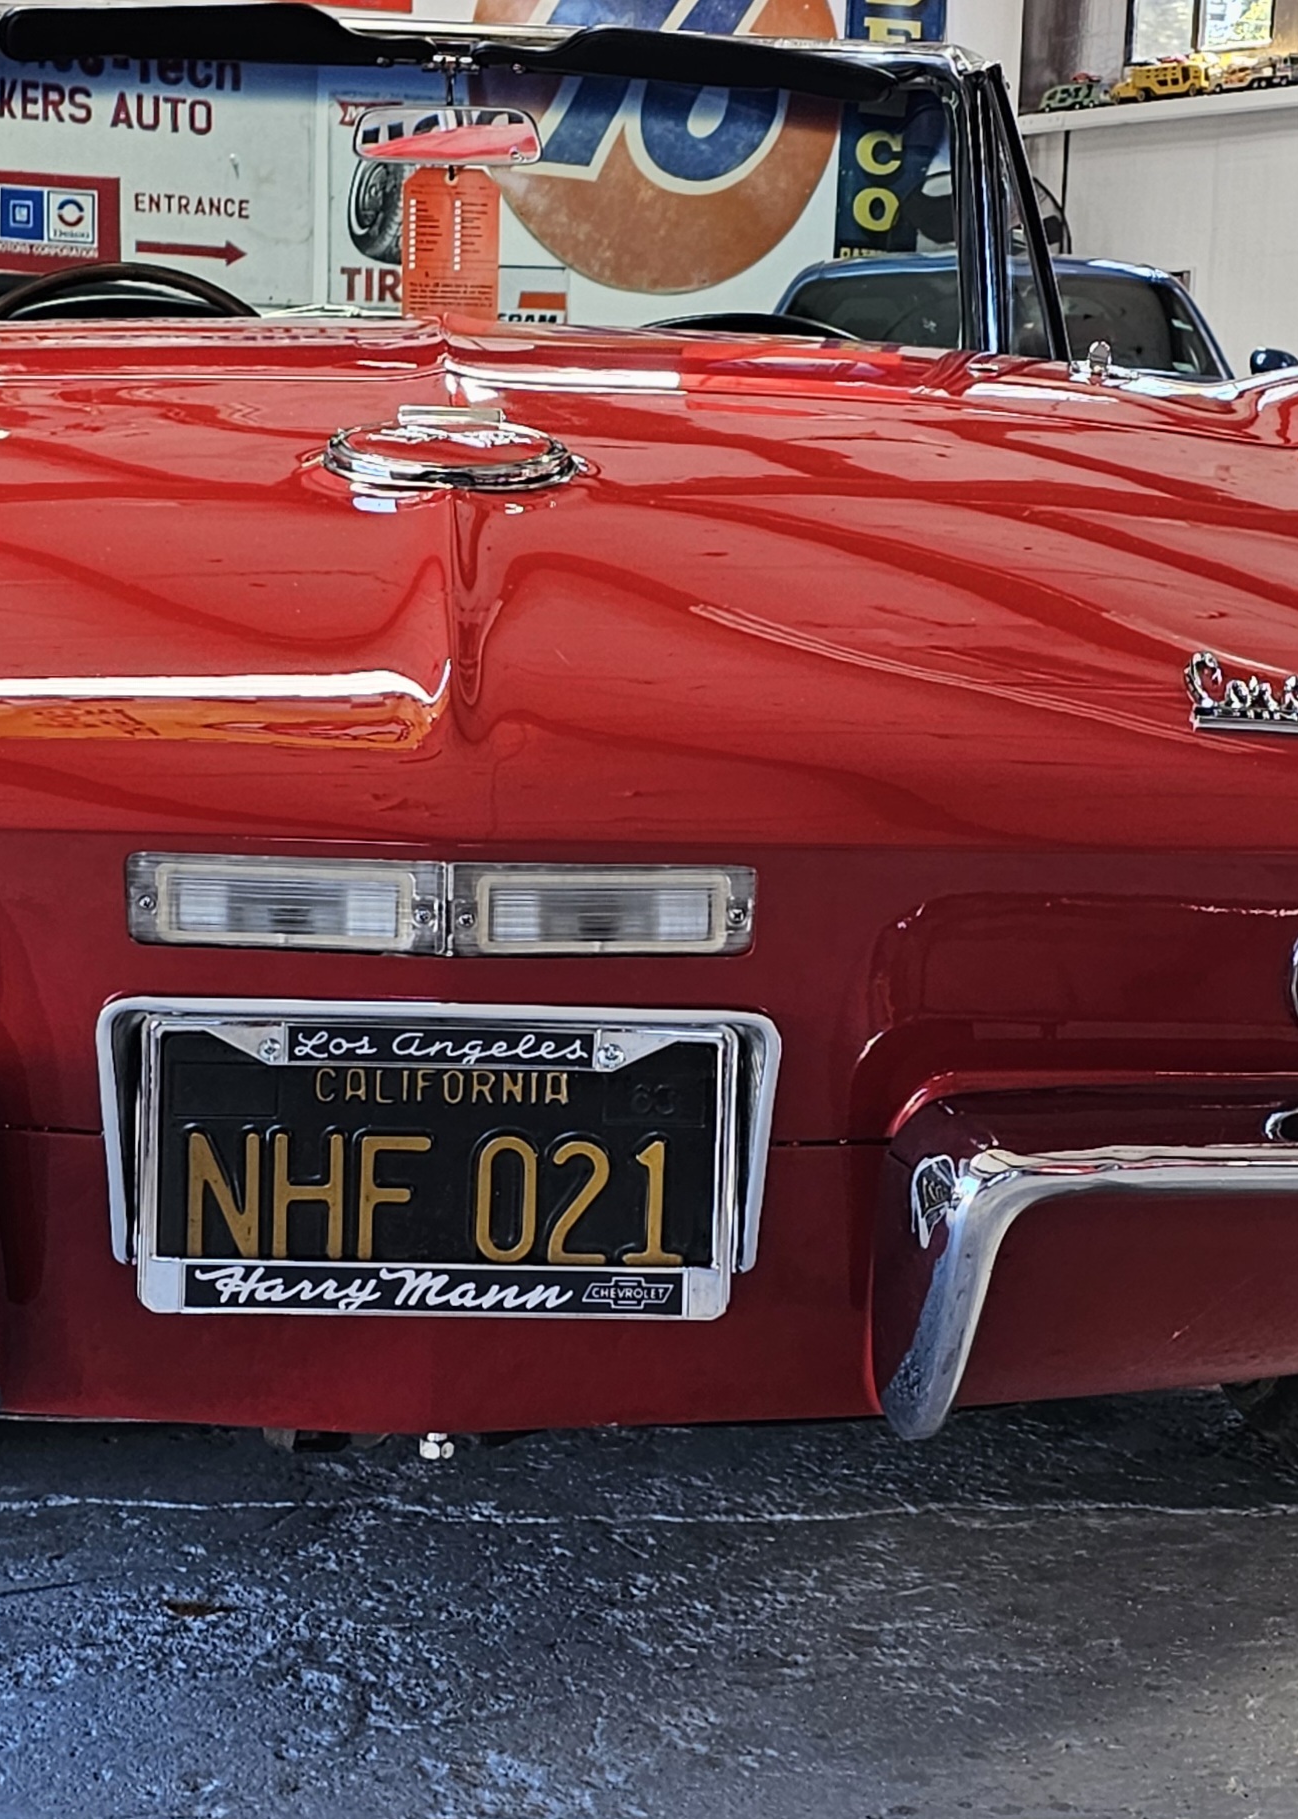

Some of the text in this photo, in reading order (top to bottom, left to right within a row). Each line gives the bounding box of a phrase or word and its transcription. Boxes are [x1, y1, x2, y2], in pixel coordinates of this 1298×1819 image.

[110, 91, 213, 135] AUTO
[134, 192, 250, 220] ENTRANCE
[293, 1029, 589, 1065] Los Angeles
[315, 1067, 570, 1105] CALIFORNIA
[187, 1132, 684, 1266] NHF 021
[195, 1268, 667, 1310] Harry Mann CHEVROLET
